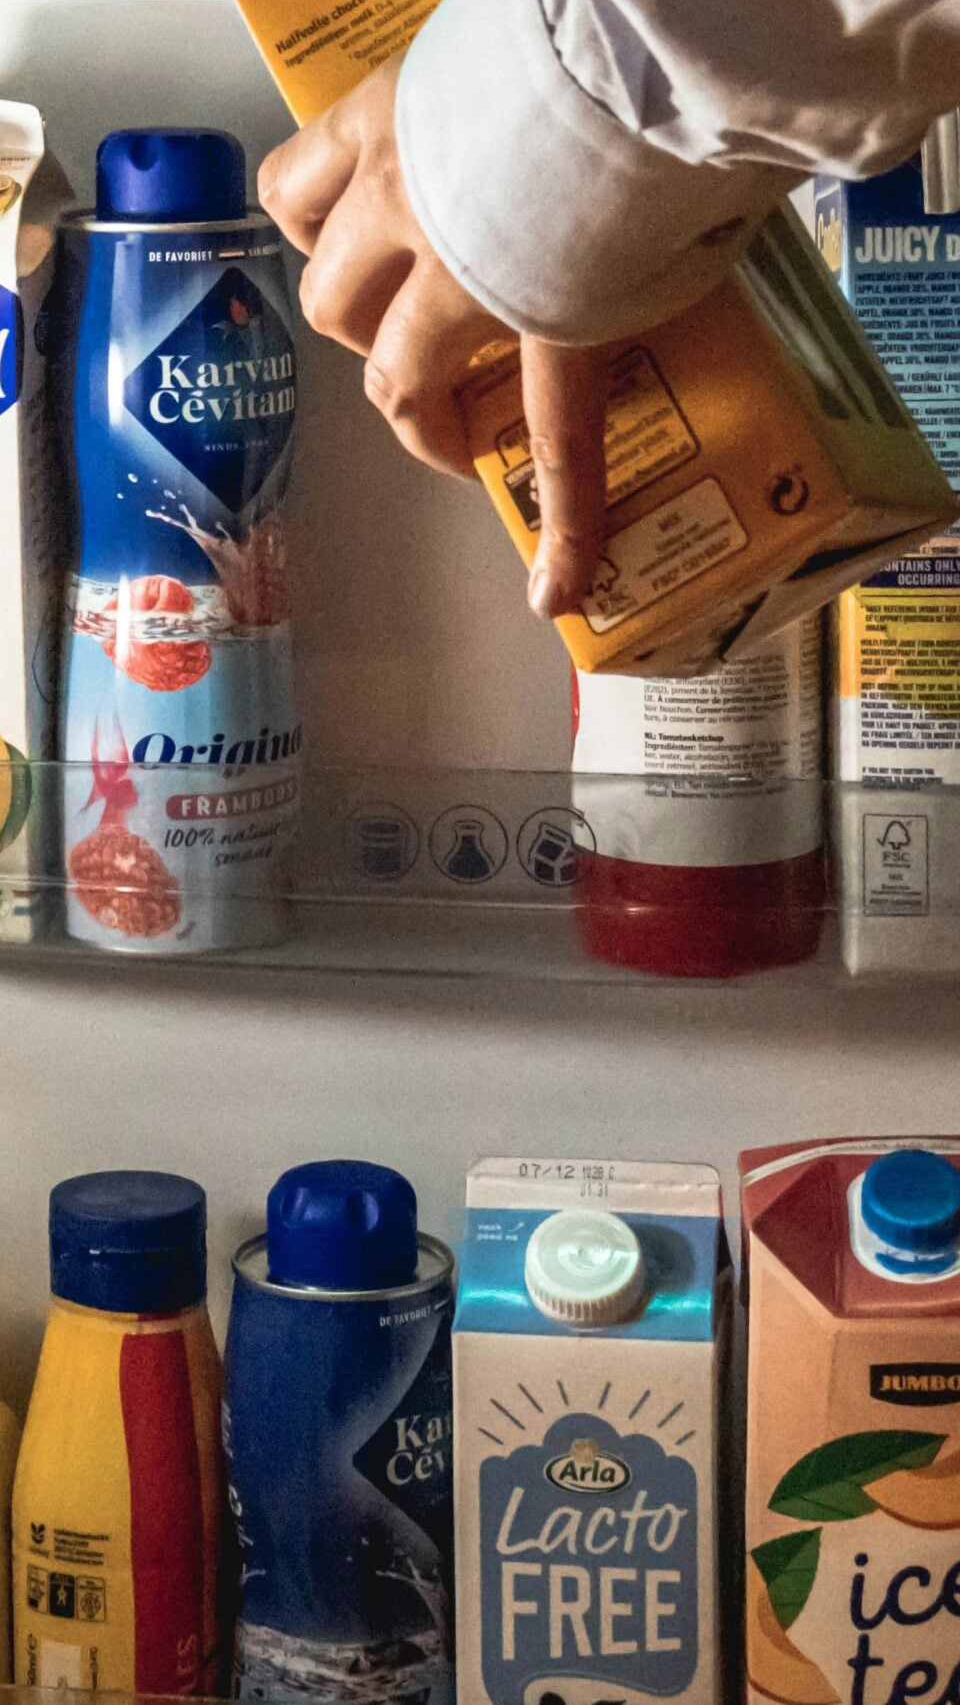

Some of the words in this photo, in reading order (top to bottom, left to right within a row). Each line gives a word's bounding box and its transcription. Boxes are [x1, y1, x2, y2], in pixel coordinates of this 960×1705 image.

[276, 16, 331, 54] Halfvolle
[855, 226, 940, 263] JUICY
[149, 252, 162, 263] DE
[165, 250, 213, 262] FAVORIET
[157, 353, 295, 389] Karvan
[665, 696, 711, 704] consommer
[885, 721, 900, 730] HAUT
[644, 732, 656, 740] NL:
[658, 732, 724, 743] Tomatenketchup
[871, 731, 888, 740] FRAIS
[645, 742, 696, 752] Ingrediënten:
[659, 752, 682, 761] water,
[164, 828, 214, 848] 100%
[883, 852, 910, 862] FSC
[518, 1163, 576, 1179] 07/12
[379, 1315, 392, 1328] DE
[394, 1306, 432, 1325] FAVORIET
[880, 1375, 960, 1391] JUMBO
[558, 1460, 616, 1483] Arla
[496, 1486, 688, 1556] Lacto
[501, 1561, 682, 1661] FREE
